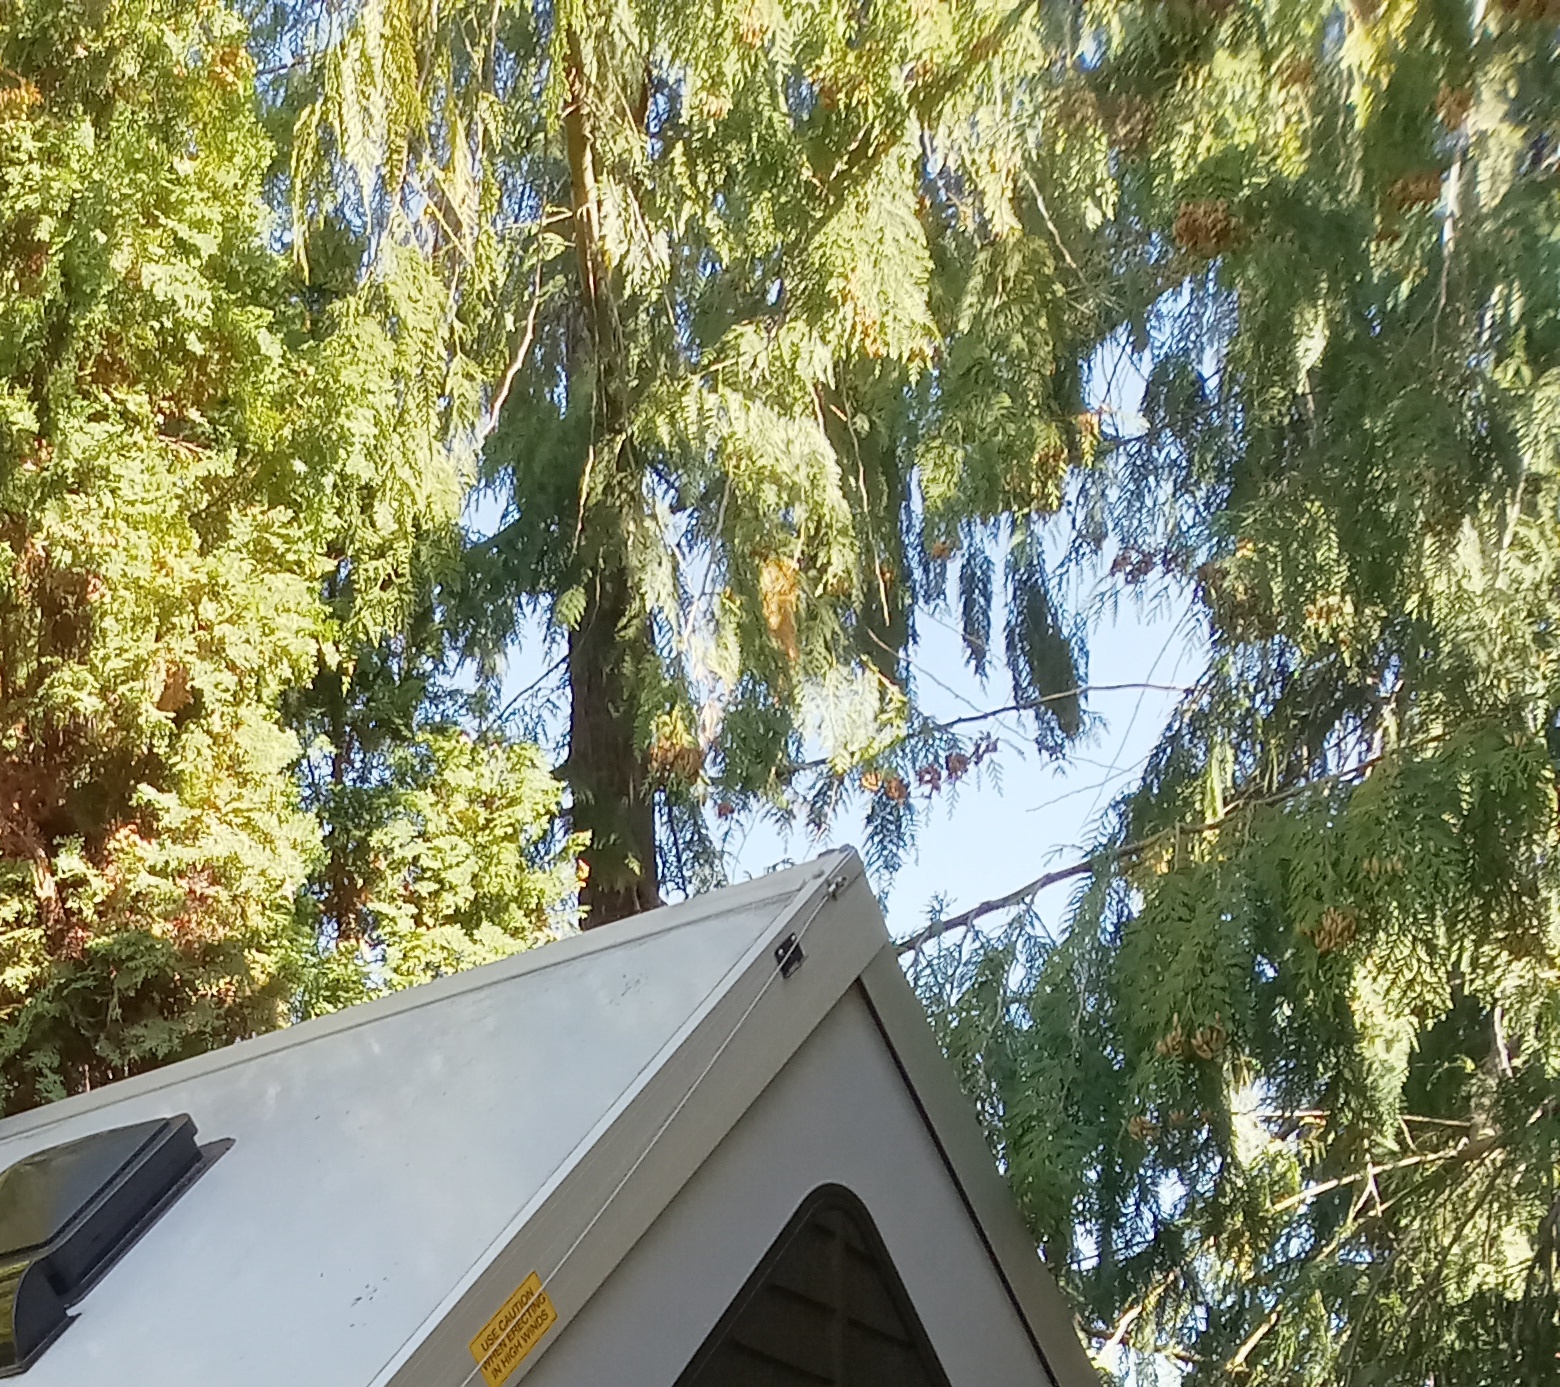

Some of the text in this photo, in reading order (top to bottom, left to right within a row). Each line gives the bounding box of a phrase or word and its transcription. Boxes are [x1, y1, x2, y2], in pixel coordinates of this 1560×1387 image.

[481, 1286, 534, 1351] USE CAUTION
[481, 1293, 546, 1372] WHEN ERECTING
[491, 1309, 549, 1380] IN HIGH WINDS
